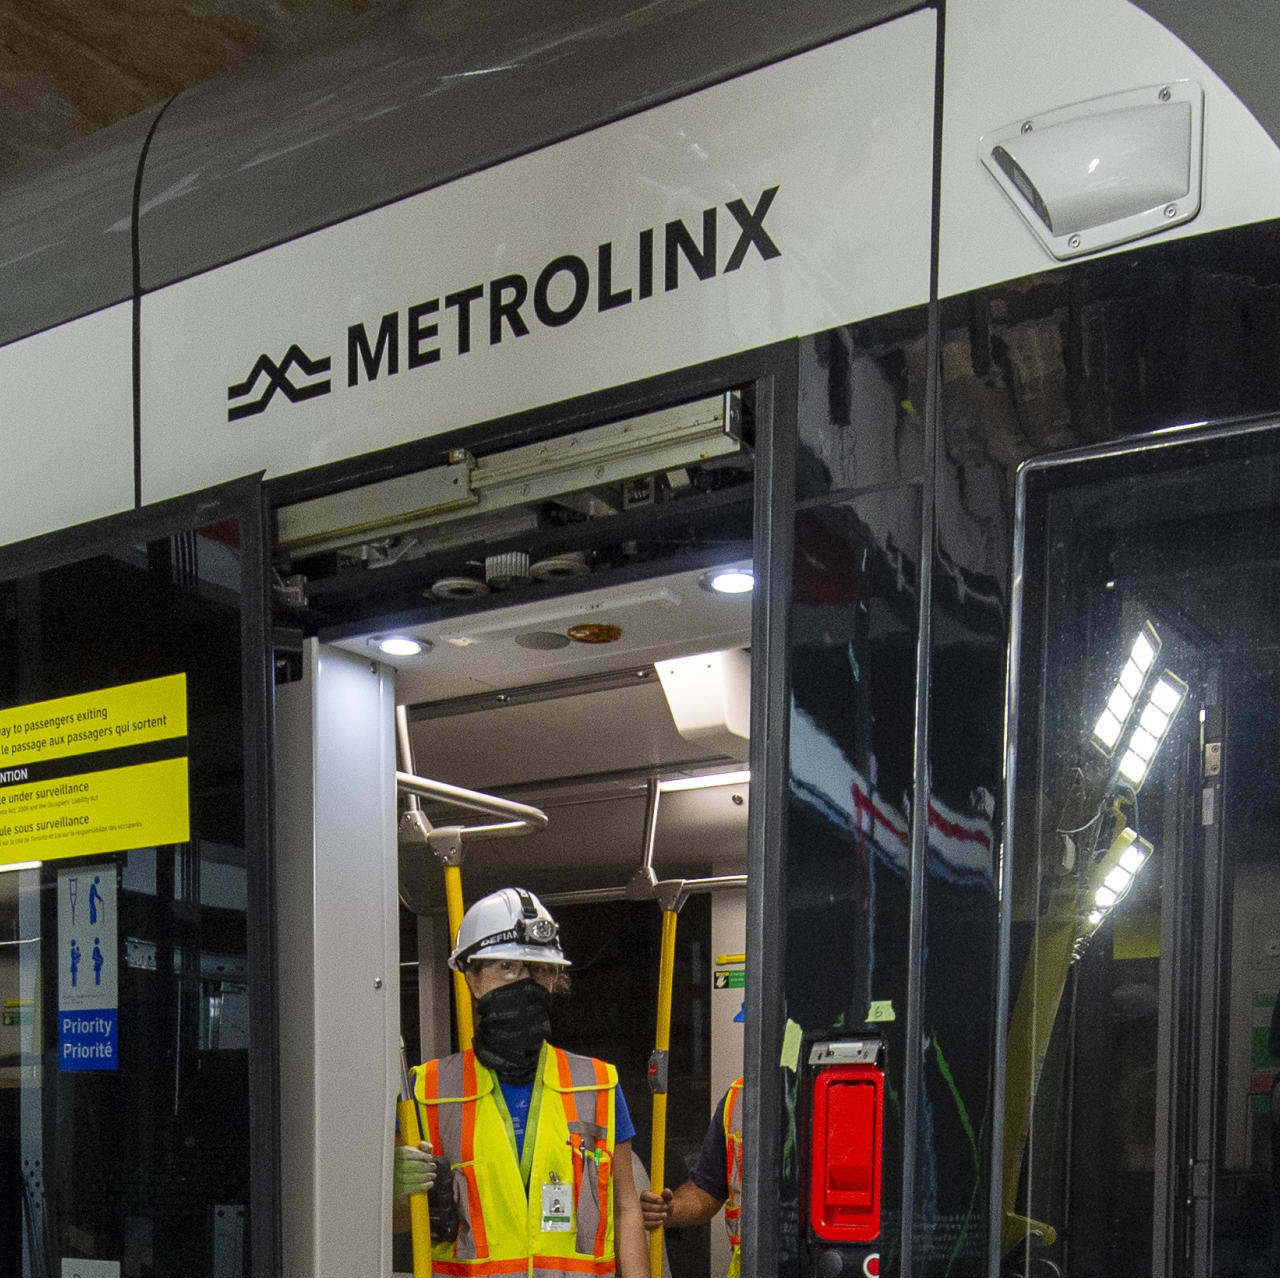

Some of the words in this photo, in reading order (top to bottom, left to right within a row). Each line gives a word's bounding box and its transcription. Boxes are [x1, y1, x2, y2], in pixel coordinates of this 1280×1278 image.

[346, 184, 781, 388] METROLINX
[13, 724, 22, 734] to
[25, 715, 74, 734] passengers
[77, 708, 108, 721] exiting
[1, 744, 9, 755] le
[11, 739, 47, 755] passage
[49, 736, 65, 746] aux
[67, 726, 113, 744] passagers
[116, 723, 130, 737] qui
[132, 715, 167, 731] sortent
[9, 791, 33, 804] under
[35, 782, 89, 800] surveillance
[14, 824, 34, 835] sous
[36, 814, 89, 831] surveillance
[63, 1017, 112, 1037] Priority
[63, 1041, 113, 1059] Priorité
